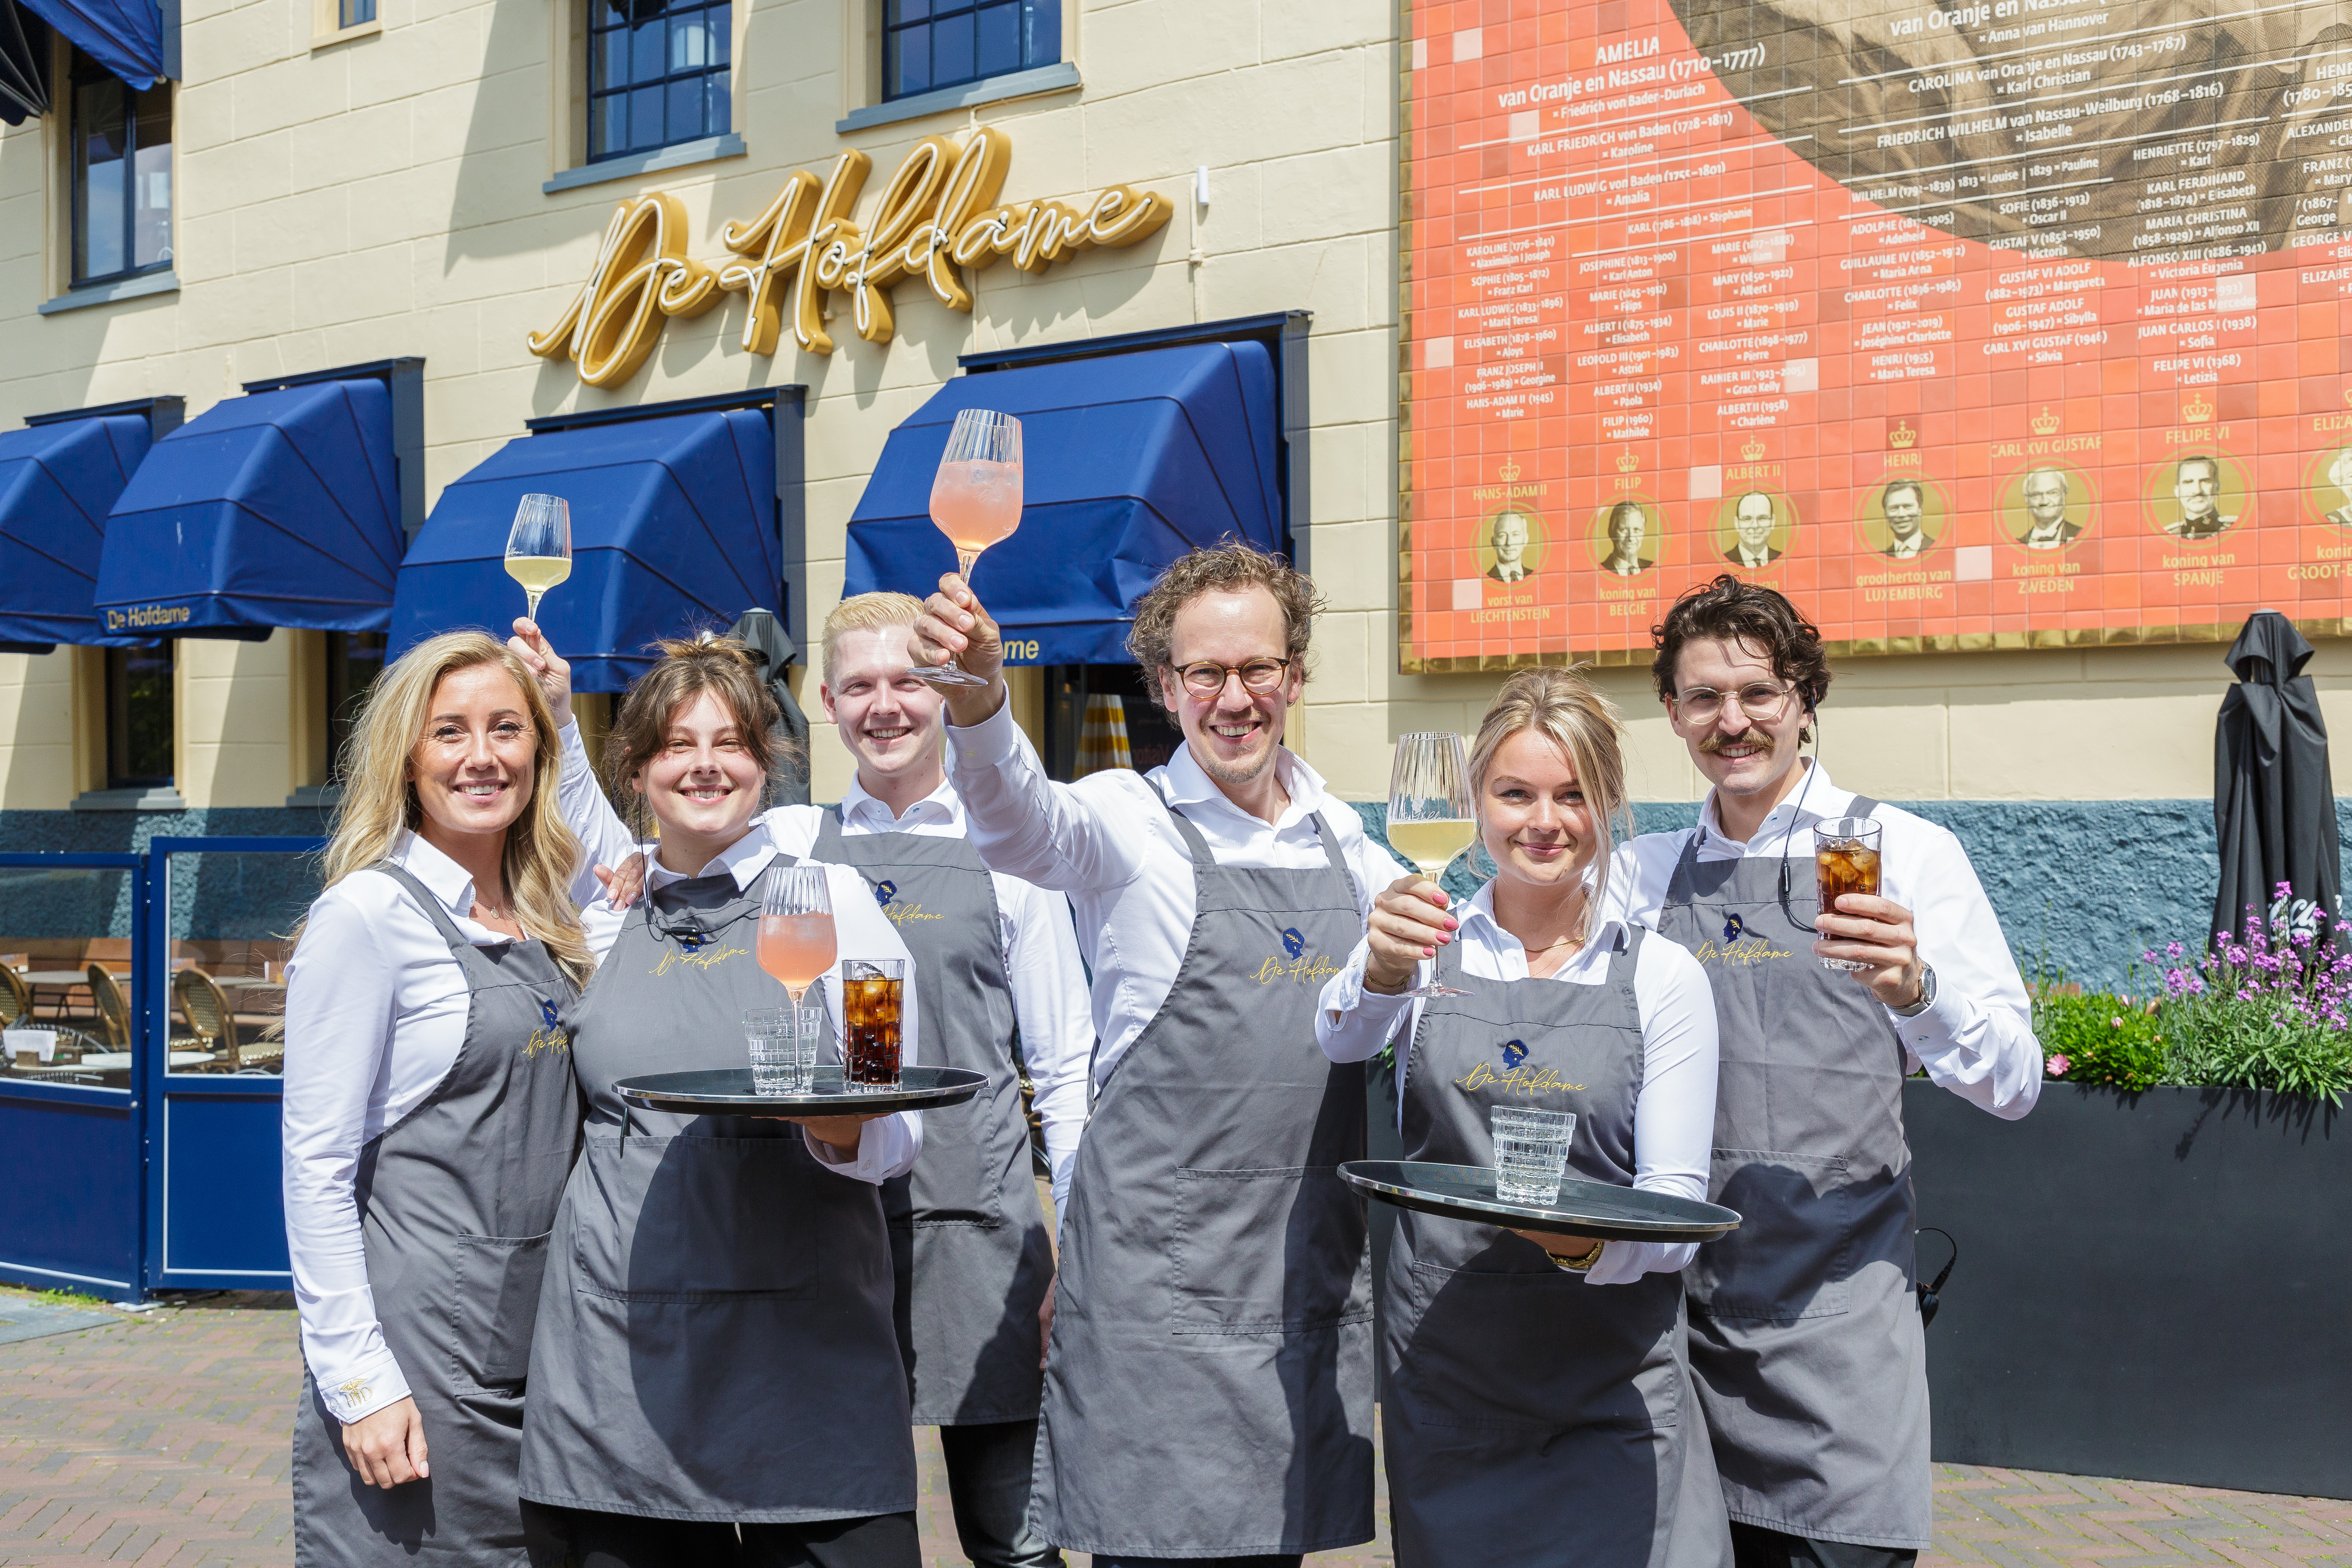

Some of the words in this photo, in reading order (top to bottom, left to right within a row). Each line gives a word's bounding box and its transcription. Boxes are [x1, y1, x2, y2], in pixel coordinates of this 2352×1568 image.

[1889, 17, 1923, 37] van
[1928, 4, 1991, 29] Oranje
[1994, 0, 2018, 18] en
[1988, 28, 2020, 43] Anna
[2022, 23, 2046, 36] van
[2048, 12, 2109, 32] Hannover
[1596, 36, 1659, 65] AMELIA
[1908, 70, 1974, 93] CAROLINA
[1976, 68, 1998, 81] van
[2000, 59, 2042, 78] Oranje
[2045, 56, 2061, 69] en
[2063, 49, 2107, 66] Nassau
[1498, 90, 1526, 108] van
[1530, 77, 1582, 106] Oranje
[1586, 75, 1604, 92] en
[1609, 63, 1666, 88] Nassau
[2007, 78, 2032, 94] Karl
[2034, 68, 2090, 89] Christian
[1561, 99, 1605, 118] Friedrich
[1607, 98, 1627, 110] von
[1877, 126, 1945, 148] FRIEDRICH
[1947, 116, 2007, 137] WILHELM
[2010, 114, 2033, 128] van
[2036, 95, 2142, 123] Nassau-Weilburg
[1527, 142, 1556, 156] KARL
[1557, 131, 1615, 151] FRIEDRICH
[1617, 129, 1637, 141] von
[1639, 122, 1671, 138] Baden
[2025, 123, 2073, 142] Isabelle
[1610, 142, 1655, 158] Karoline
[2133, 142, 2194, 160] HENRIETTE
[2189, 155, 2211, 167] Karl
[2303, 157, 2343, 174] FRANZ
[1850, 187, 1897, 203] WILHELM
[1958, 175, 1979, 189] 1813
[1987, 168, 2019, 184] Louise
[2030, 164, 2052, 178] 1829
[2061, 157, 2099, 172] Pauline
[2323, 172, 2352, 186] Mary
[1534, 187, 1562, 202] KARL
[1609, 179, 1629, 190] von
[1630, 172, 1663, 187] Baden
[2147, 180, 2176, 194] KARL
[1614, 189, 1650, 206] Amalia
[2000, 201, 2029, 214] SOFIE
[2029, 212, 2058, 224] Oscar
[2146, 216, 2183, 229] MARIA
[2185, 207, 2247, 225] CHRISTINA
[2296, 212, 2336, 226] George
[1627, 222, 1650, 234] KARL
[2203, 224, 2244, 238] Alfonso
[2291, 232, 2340, 248] GEORGE
[527, 192, 718, 389] De
[718, 126, 1173, 356] Hofdame
[2029, 245, 2068, 259] Victoria
[2127, 252, 2180, 268] ALFONSO
[1626, 268, 1653, 279] Anton
[1999, 269, 2039, 284] GUSTAF
[2055, 262, 2090, 276] ADOLF
[2158, 265, 2200, 279] Victoria
[2053, 277, 2105, 291] Margareta
[1844, 287, 1901, 303] CHARLOTTE
[2151, 288, 2178, 300] JUAN
[1458, 308, 1479, 318] KARL
[2005, 303, 2046, 317] GUSTAF
[2049, 298, 2083, 312] ADOLF
[2144, 303, 2175, 315] Maria
[2176, 302, 2190, 313] de
[2191, 301, 2207, 312] las
[2064, 311, 2097, 325] Sibylla
[1584, 322, 1616, 334] ALBERT
[1862, 322, 1886, 334] JEAN
[2138, 325, 2167, 337] JUAN
[2169, 320, 2214, 334] CARLOS
[1464, 335, 1508, 349] ELISABETH
[1906, 329, 1952, 343] Charlotte
[2187, 335, 2215, 348] Sofia
[1699, 337, 1754, 352] CHARLOTTE
[1983, 342, 2010, 355] CARL
[2032, 334, 2072, 349] GUSTAF
[2035, 351, 2063, 362] Silvia
[1476, 366, 1504, 377] FRANZ
[1618, 364, 1643, 374] Astrid
[2153, 359, 2190, 372] FELIPE
[1593, 384, 1626, 396] ALBERT
[1758, 380, 1780, 392] Kelly
[1466, 396, 1518, 408] HANS-ADAM
[1717, 403, 1751, 415] ALBERT
[1603, 416, 1625, 427] FILIP
[2165, 428, 2211, 443] FELIPE
[1989, 443, 2022, 458] CARL
[2051, 436, 2101, 452] GUSTAF
[1726, 465, 1768, 480] ALBERT
[1614, 477, 1642, 490] FILIP
[1473, 486, 1538, 500] HANS-ADAM
[2162, 554, 2208, 568] koning
[2211, 553, 2235, 565] van
[2012, 562, 2055, 577] koning
[2058, 562, 2080, 573] van
[1856, 571, 1927, 587] groothertog
[1929, 570, 1955, 581] van
[2173, 570, 2223, 586] SPANJE
[1487, 596, 1513, 606] vorst
[1514, 595, 1533, 604] van
[1597, 589, 1635, 600] koning
[1637, 587, 1660, 598] van
[1865, 586, 1943, 602] LUXEMBURG
[1610, 601, 1646, 616] BELGIË
[107, 609, 126, 630] De
[128, 604, 191, 627] Hofdame
[679, 943, 750, 970] Hofdame
[1694, 940, 1719, 965] De
[1721, 939, 1794, 966] Hofdame
[1249, 956, 1287, 984] De
[522, 1029, 546, 1058] De
[1455, 1063, 1498, 1091] De
[1501, 1066, 1588, 1095] Hofdame
